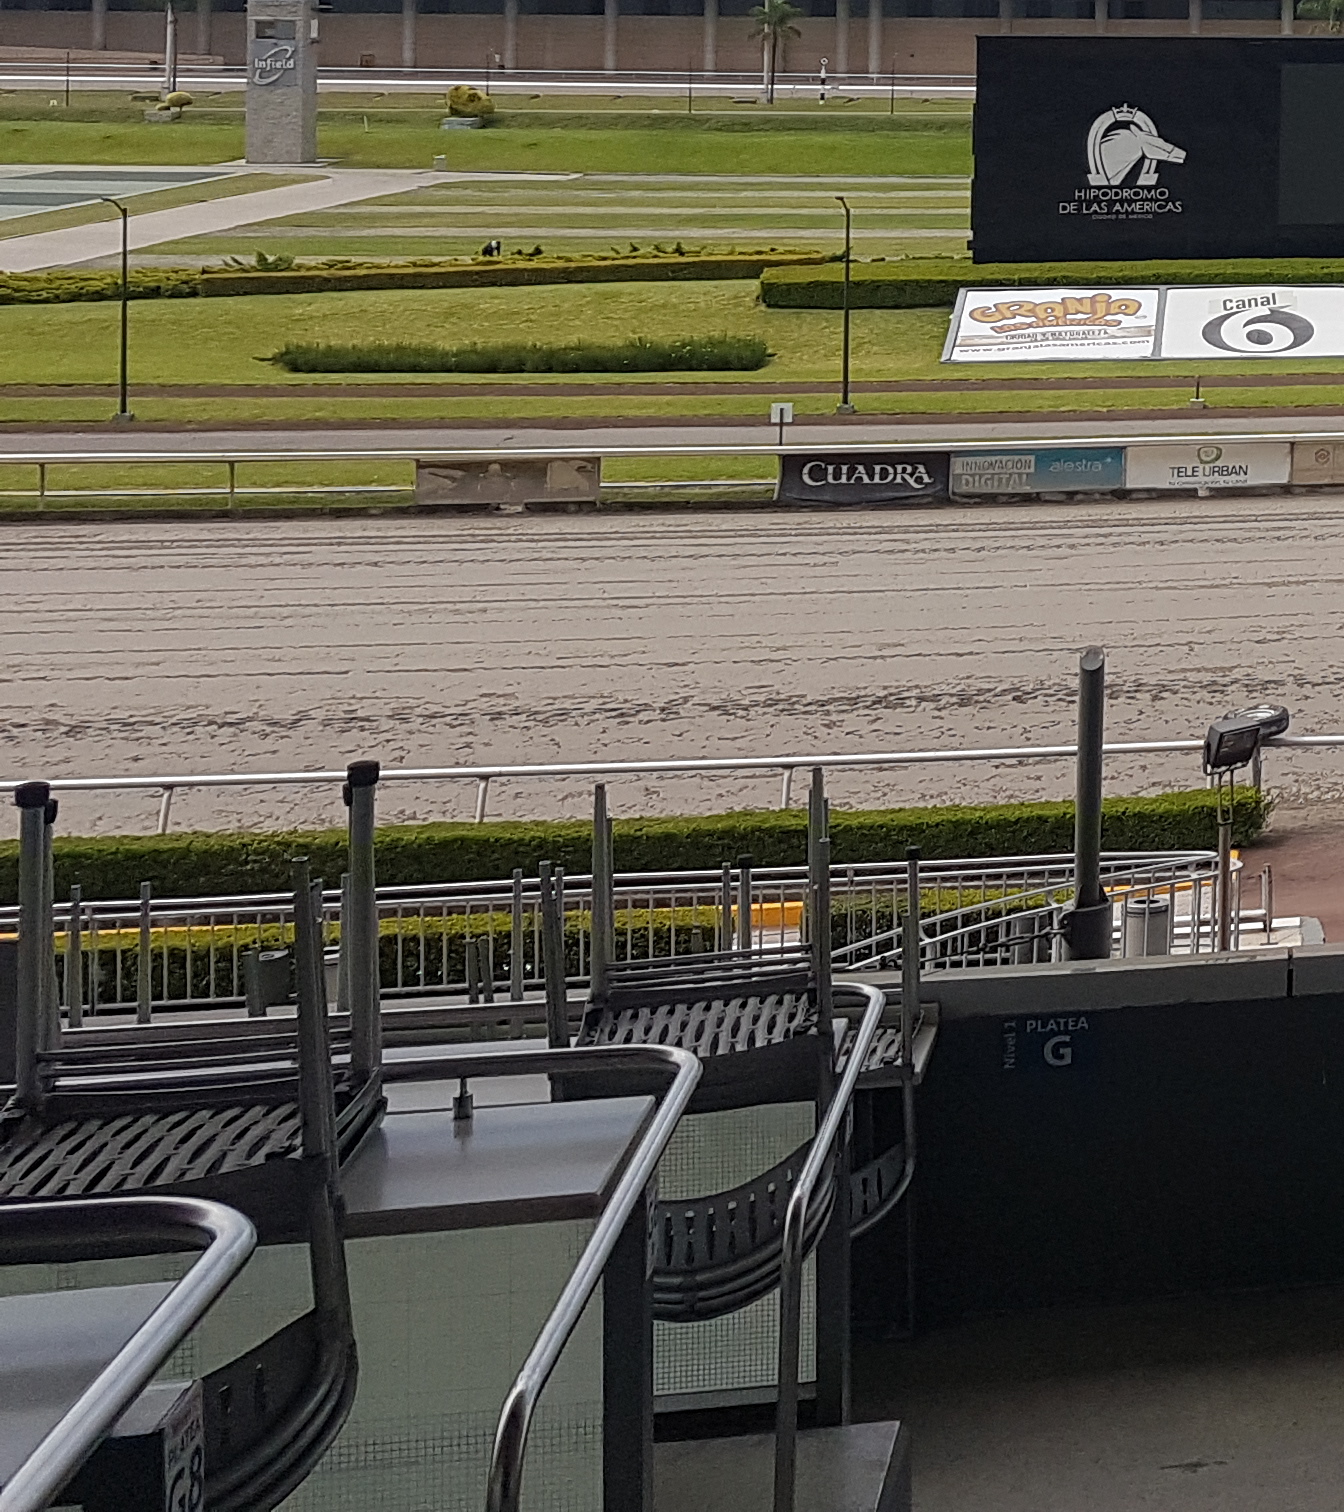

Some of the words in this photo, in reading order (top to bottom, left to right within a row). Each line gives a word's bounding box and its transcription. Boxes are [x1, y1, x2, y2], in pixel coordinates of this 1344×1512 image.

[254, 58, 294, 71] Infield
[1074, 188, 1170, 200] HIPODROMO
[1059, 202, 1078, 214] DE
[1083, 202, 1108, 214] LAS
[1112, 201, 1183, 213] AMERICAS
[1222, 292, 1277, 311] Canal
[1050, 458, 1102, 473] alestra
[1169, 465, 1200, 478] TELE
[1203, 464, 1248, 478] URBAN
[801, 461, 934, 489] CUADRA
[961, 473, 1032, 490] DIGITAL
[1026, 1016, 1089, 1033] PLATEA
[1003, 1033, 1016, 1069] Nivel
[1044, 1035, 1072, 1066] G
